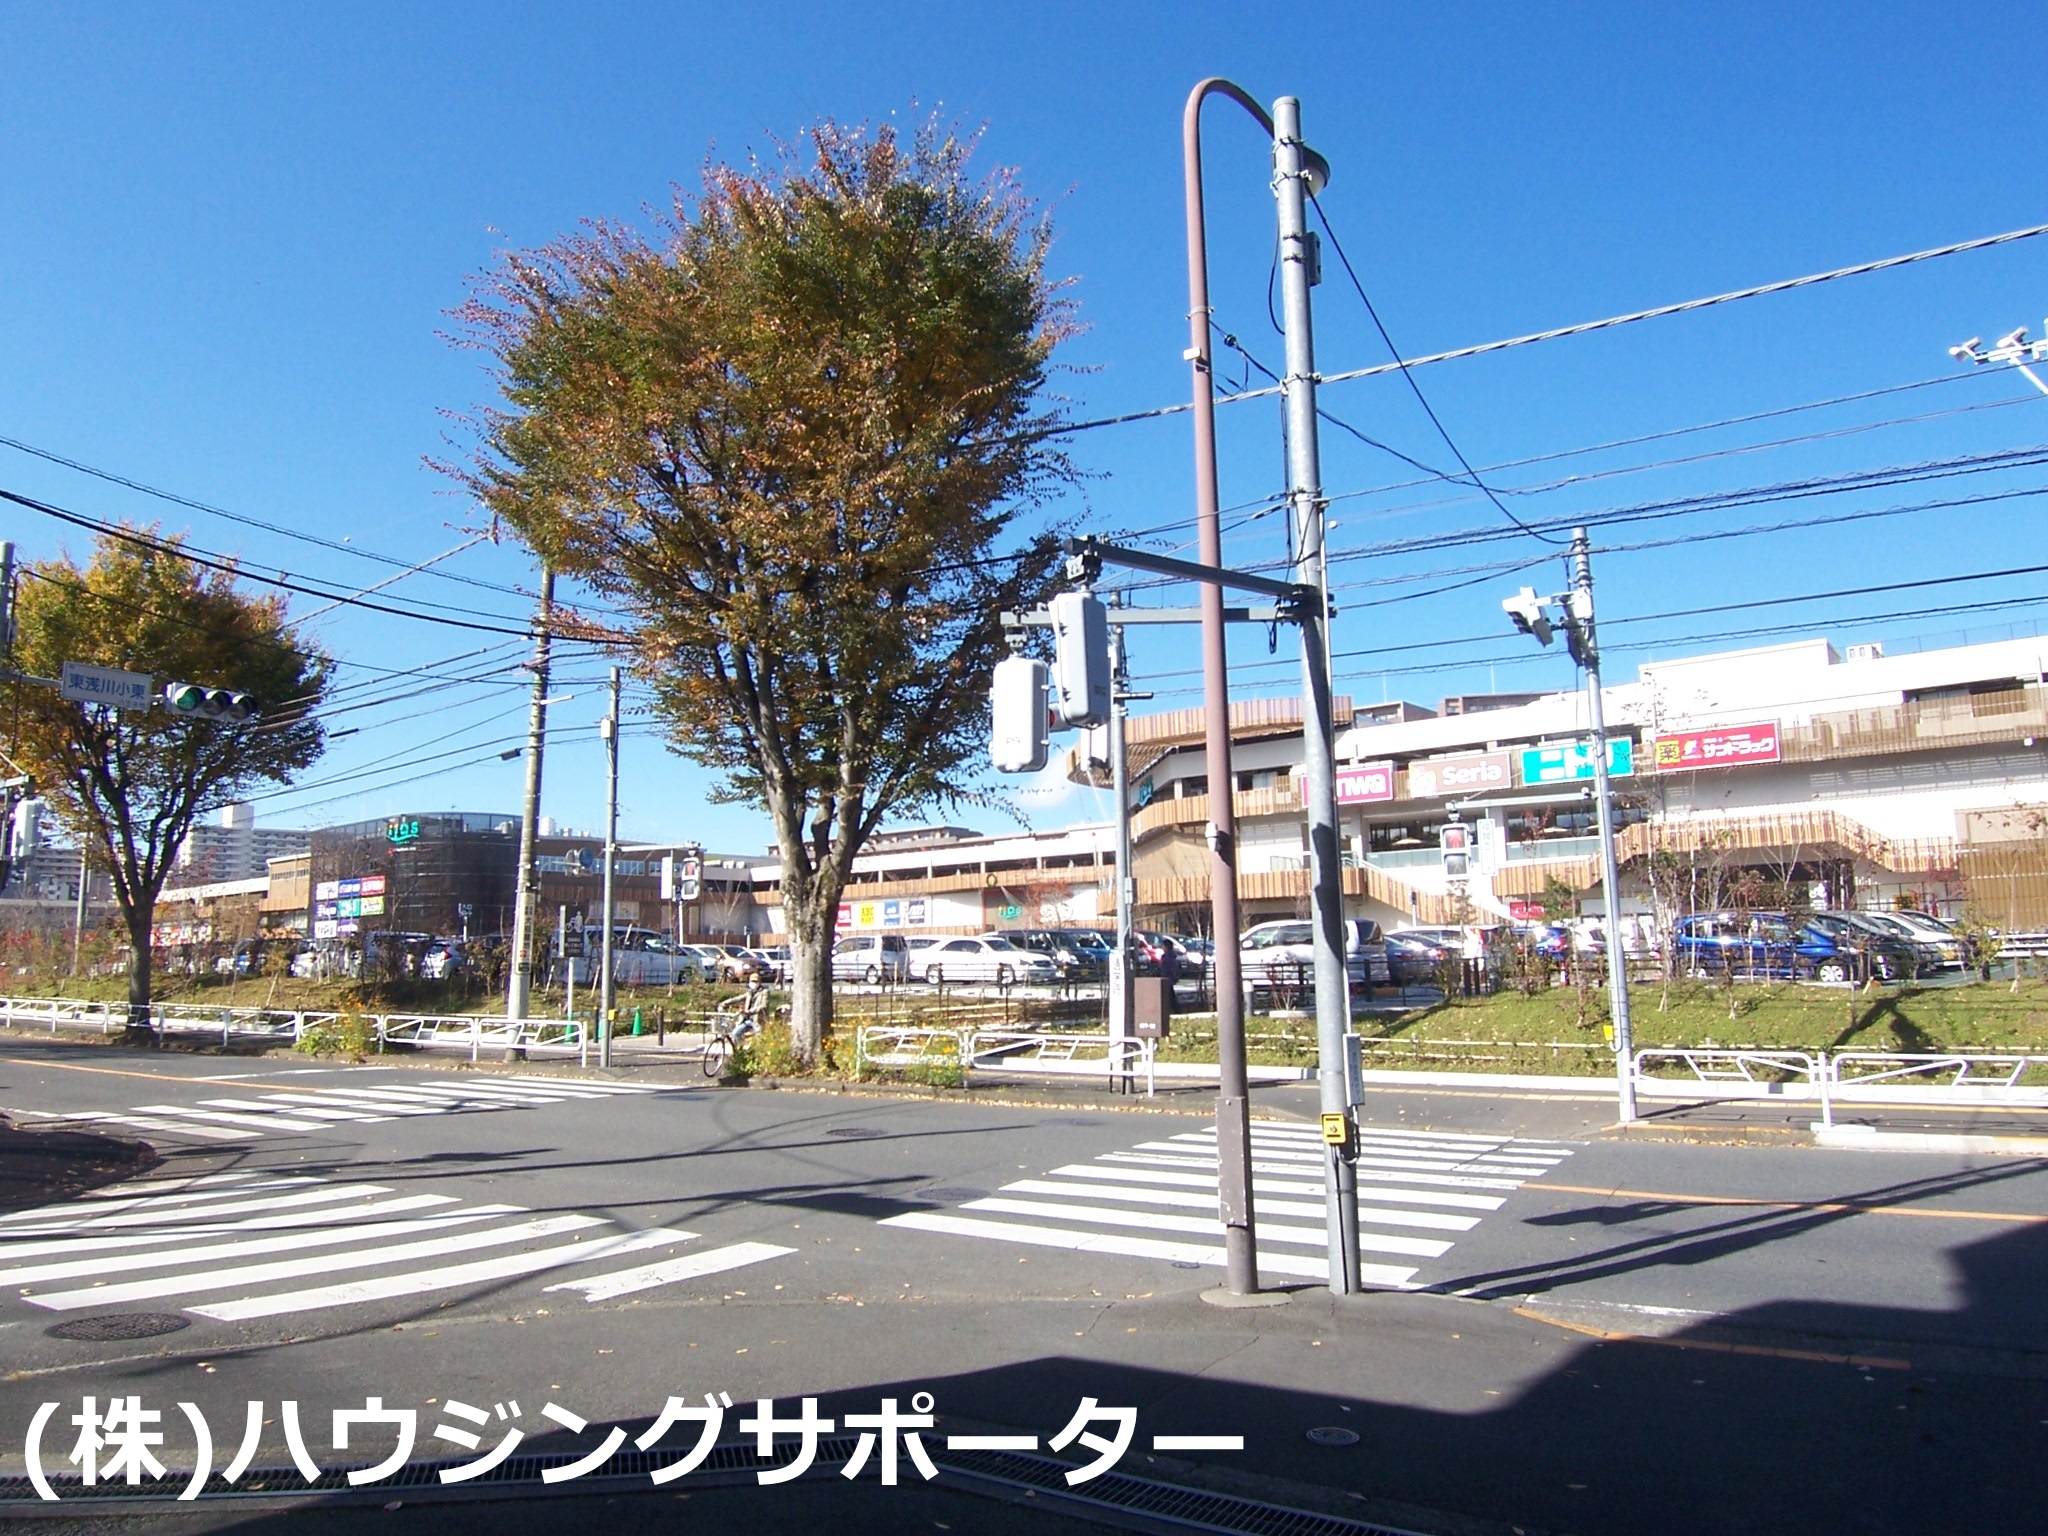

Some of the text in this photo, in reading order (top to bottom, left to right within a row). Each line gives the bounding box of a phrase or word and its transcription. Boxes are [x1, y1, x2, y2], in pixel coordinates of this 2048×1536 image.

[68, 673, 146, 699] 東浅川小東
[1442, 761, 1503, 787] Seria
[1540, 744, 1614, 780] ニトリ
